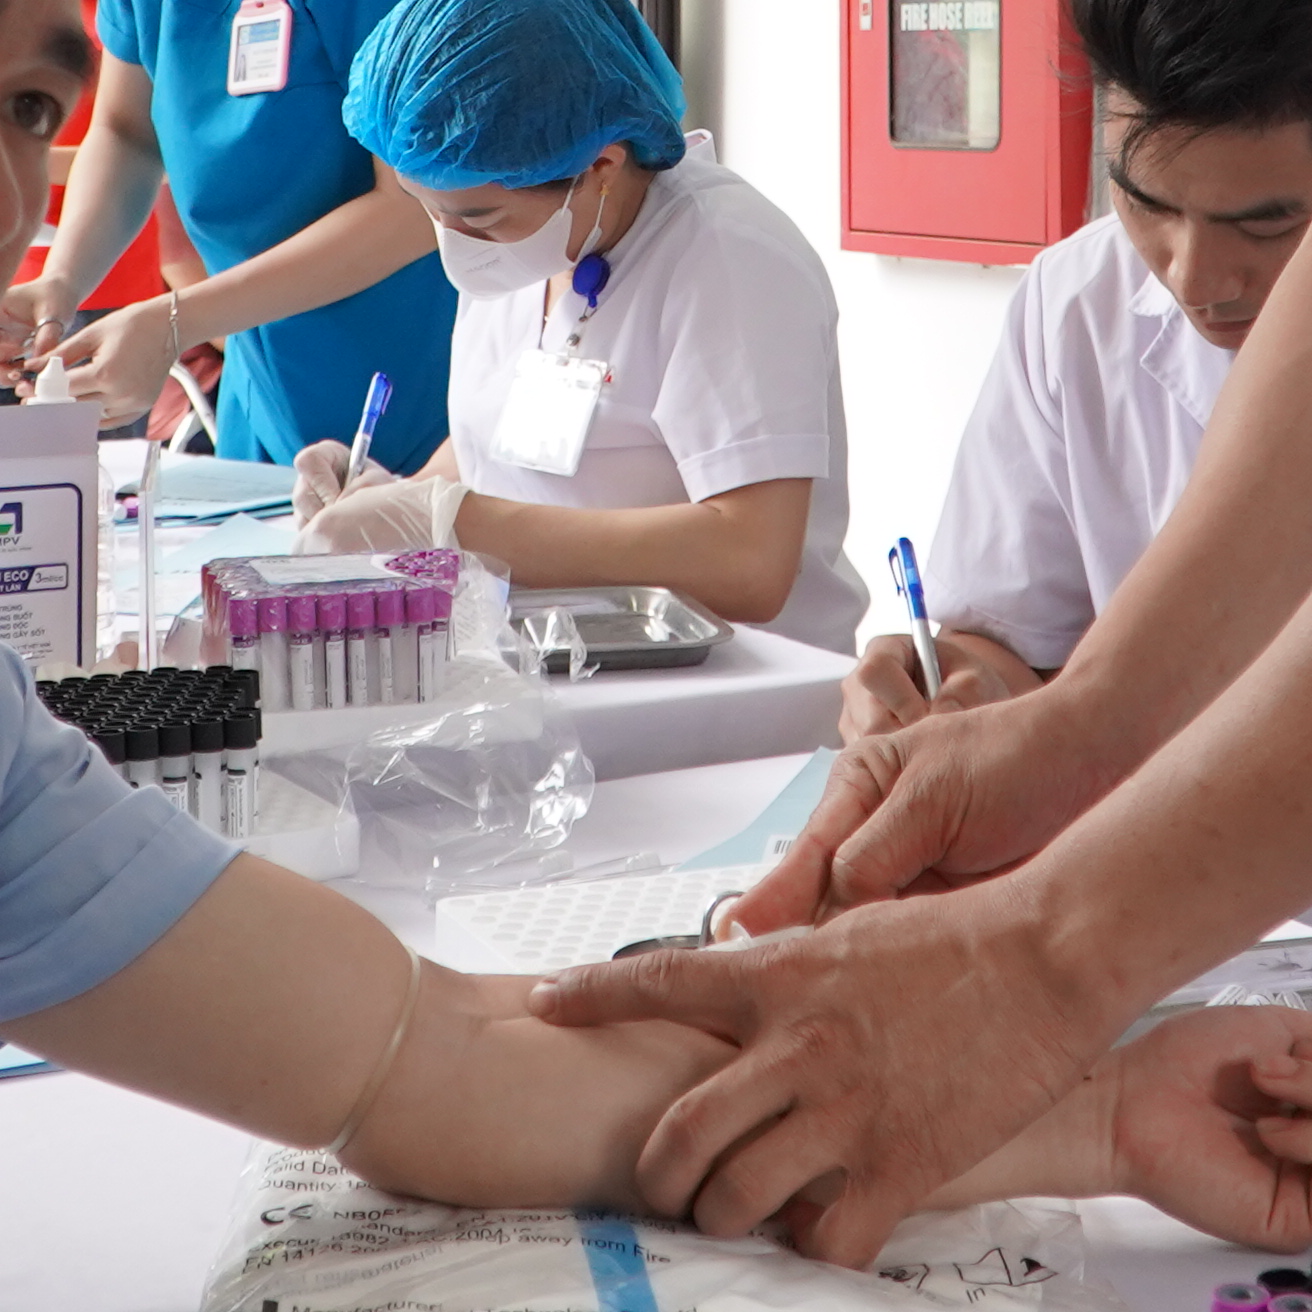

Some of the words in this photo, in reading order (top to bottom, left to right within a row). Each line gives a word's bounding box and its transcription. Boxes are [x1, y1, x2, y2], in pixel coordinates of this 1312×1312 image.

[900, 2, 928, 31] FIRE
[929, 1, 963, 30] HOSE
[3, 569, 29, 583] ECO
[633, 1244, 672, 1264] Fire
